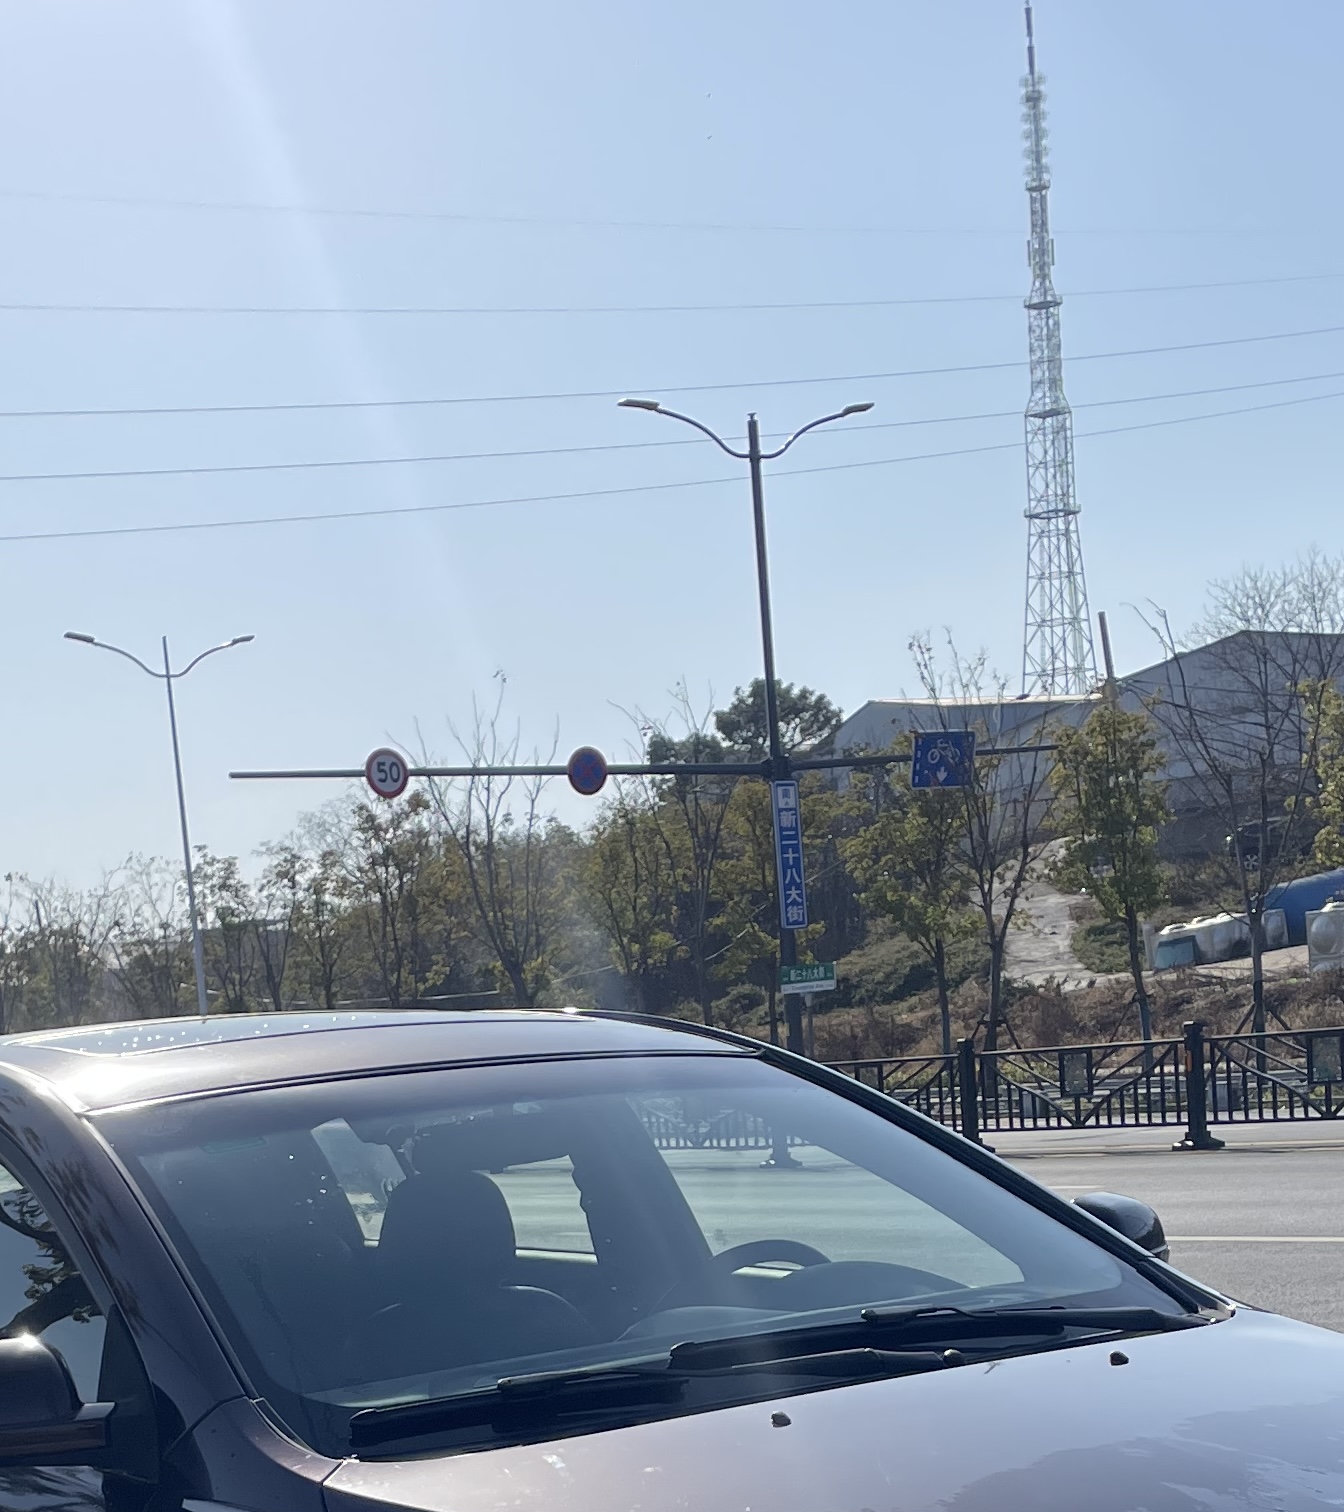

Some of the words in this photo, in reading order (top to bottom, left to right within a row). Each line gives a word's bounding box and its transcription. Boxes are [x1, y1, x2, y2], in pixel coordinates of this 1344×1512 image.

[377, 761, 400, 783] 50
[779, 811, 804, 923] 新二十八大街
